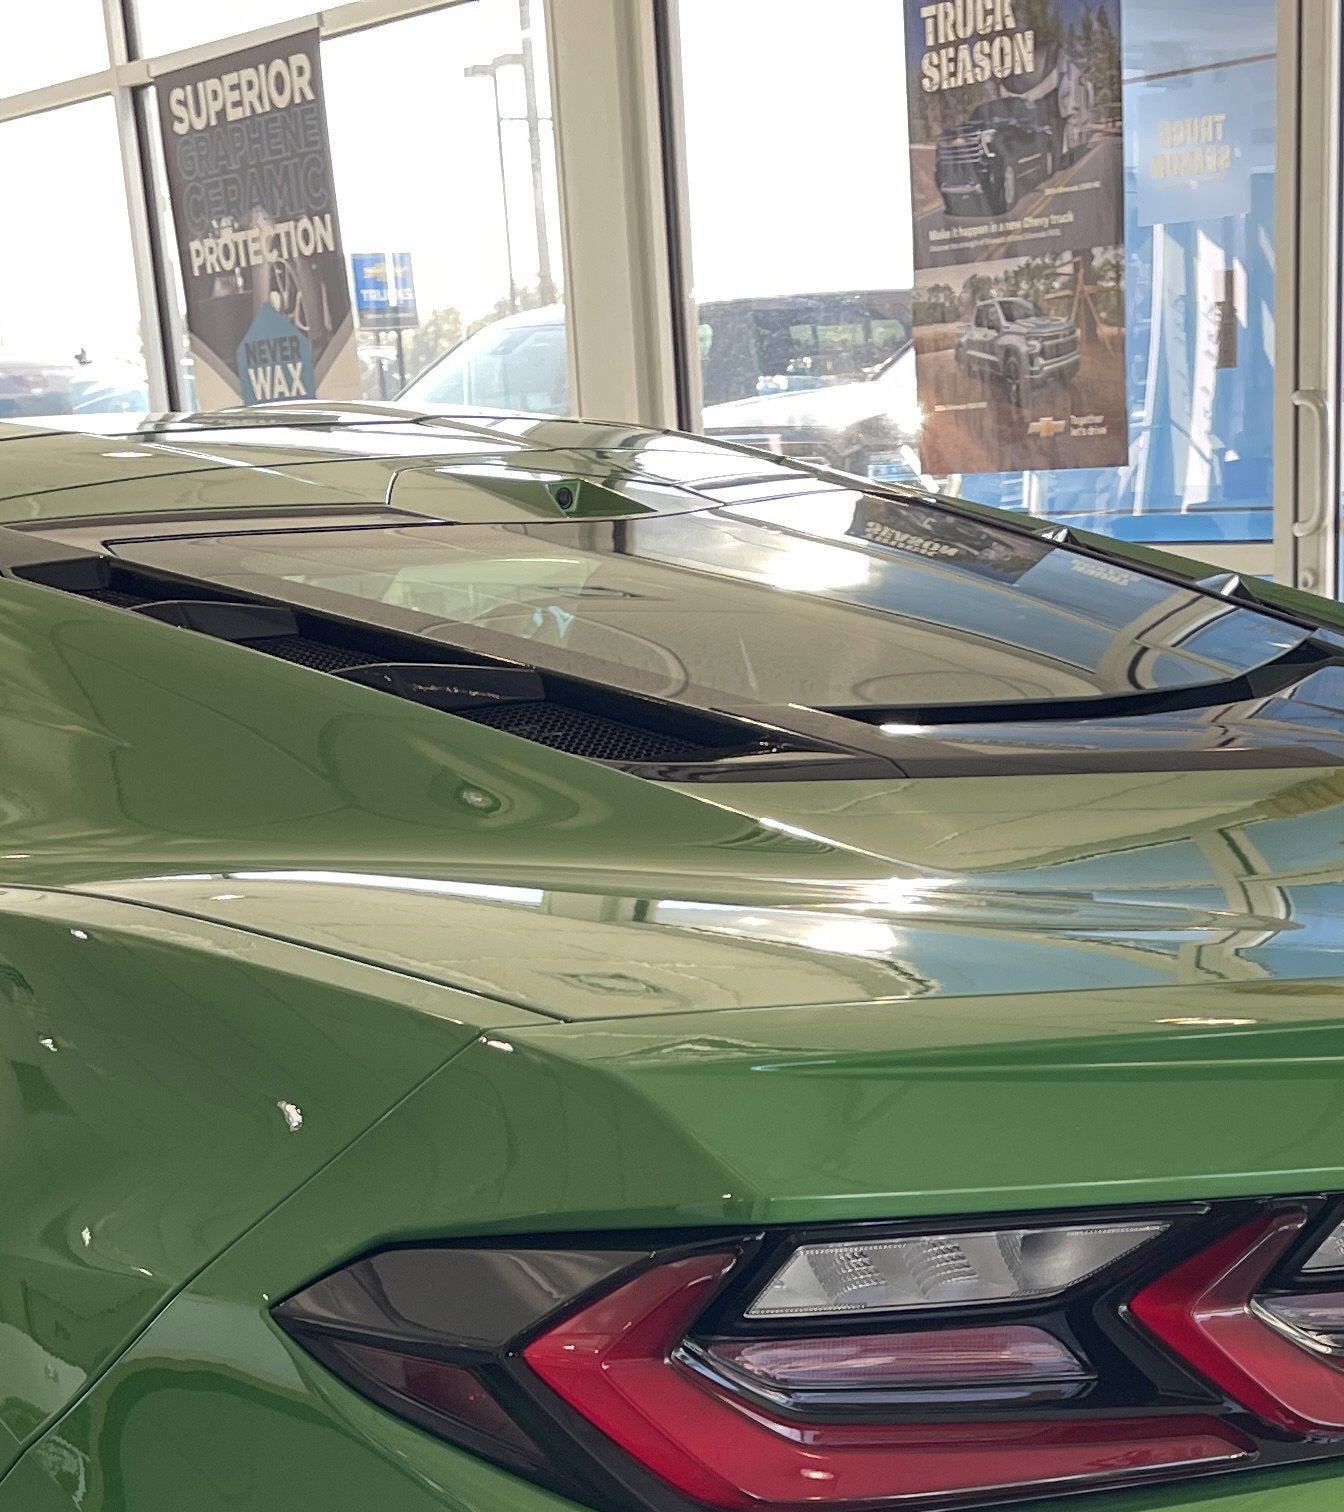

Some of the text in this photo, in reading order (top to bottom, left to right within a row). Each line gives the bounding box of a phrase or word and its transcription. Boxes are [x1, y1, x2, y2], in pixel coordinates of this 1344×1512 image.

[920, 0, 1016, 46] TRUCK
[921, 30, 1035, 93] SEASON
[169, 53, 316, 136] SUPERIOR
[175, 104, 323, 182] GRAPHENE
[183, 153, 331, 237] CERAMIC
[189, 214, 335, 277] PROTECTION
[243, 335, 302, 367] NEVER
[248, 361, 307, 400] WAX
